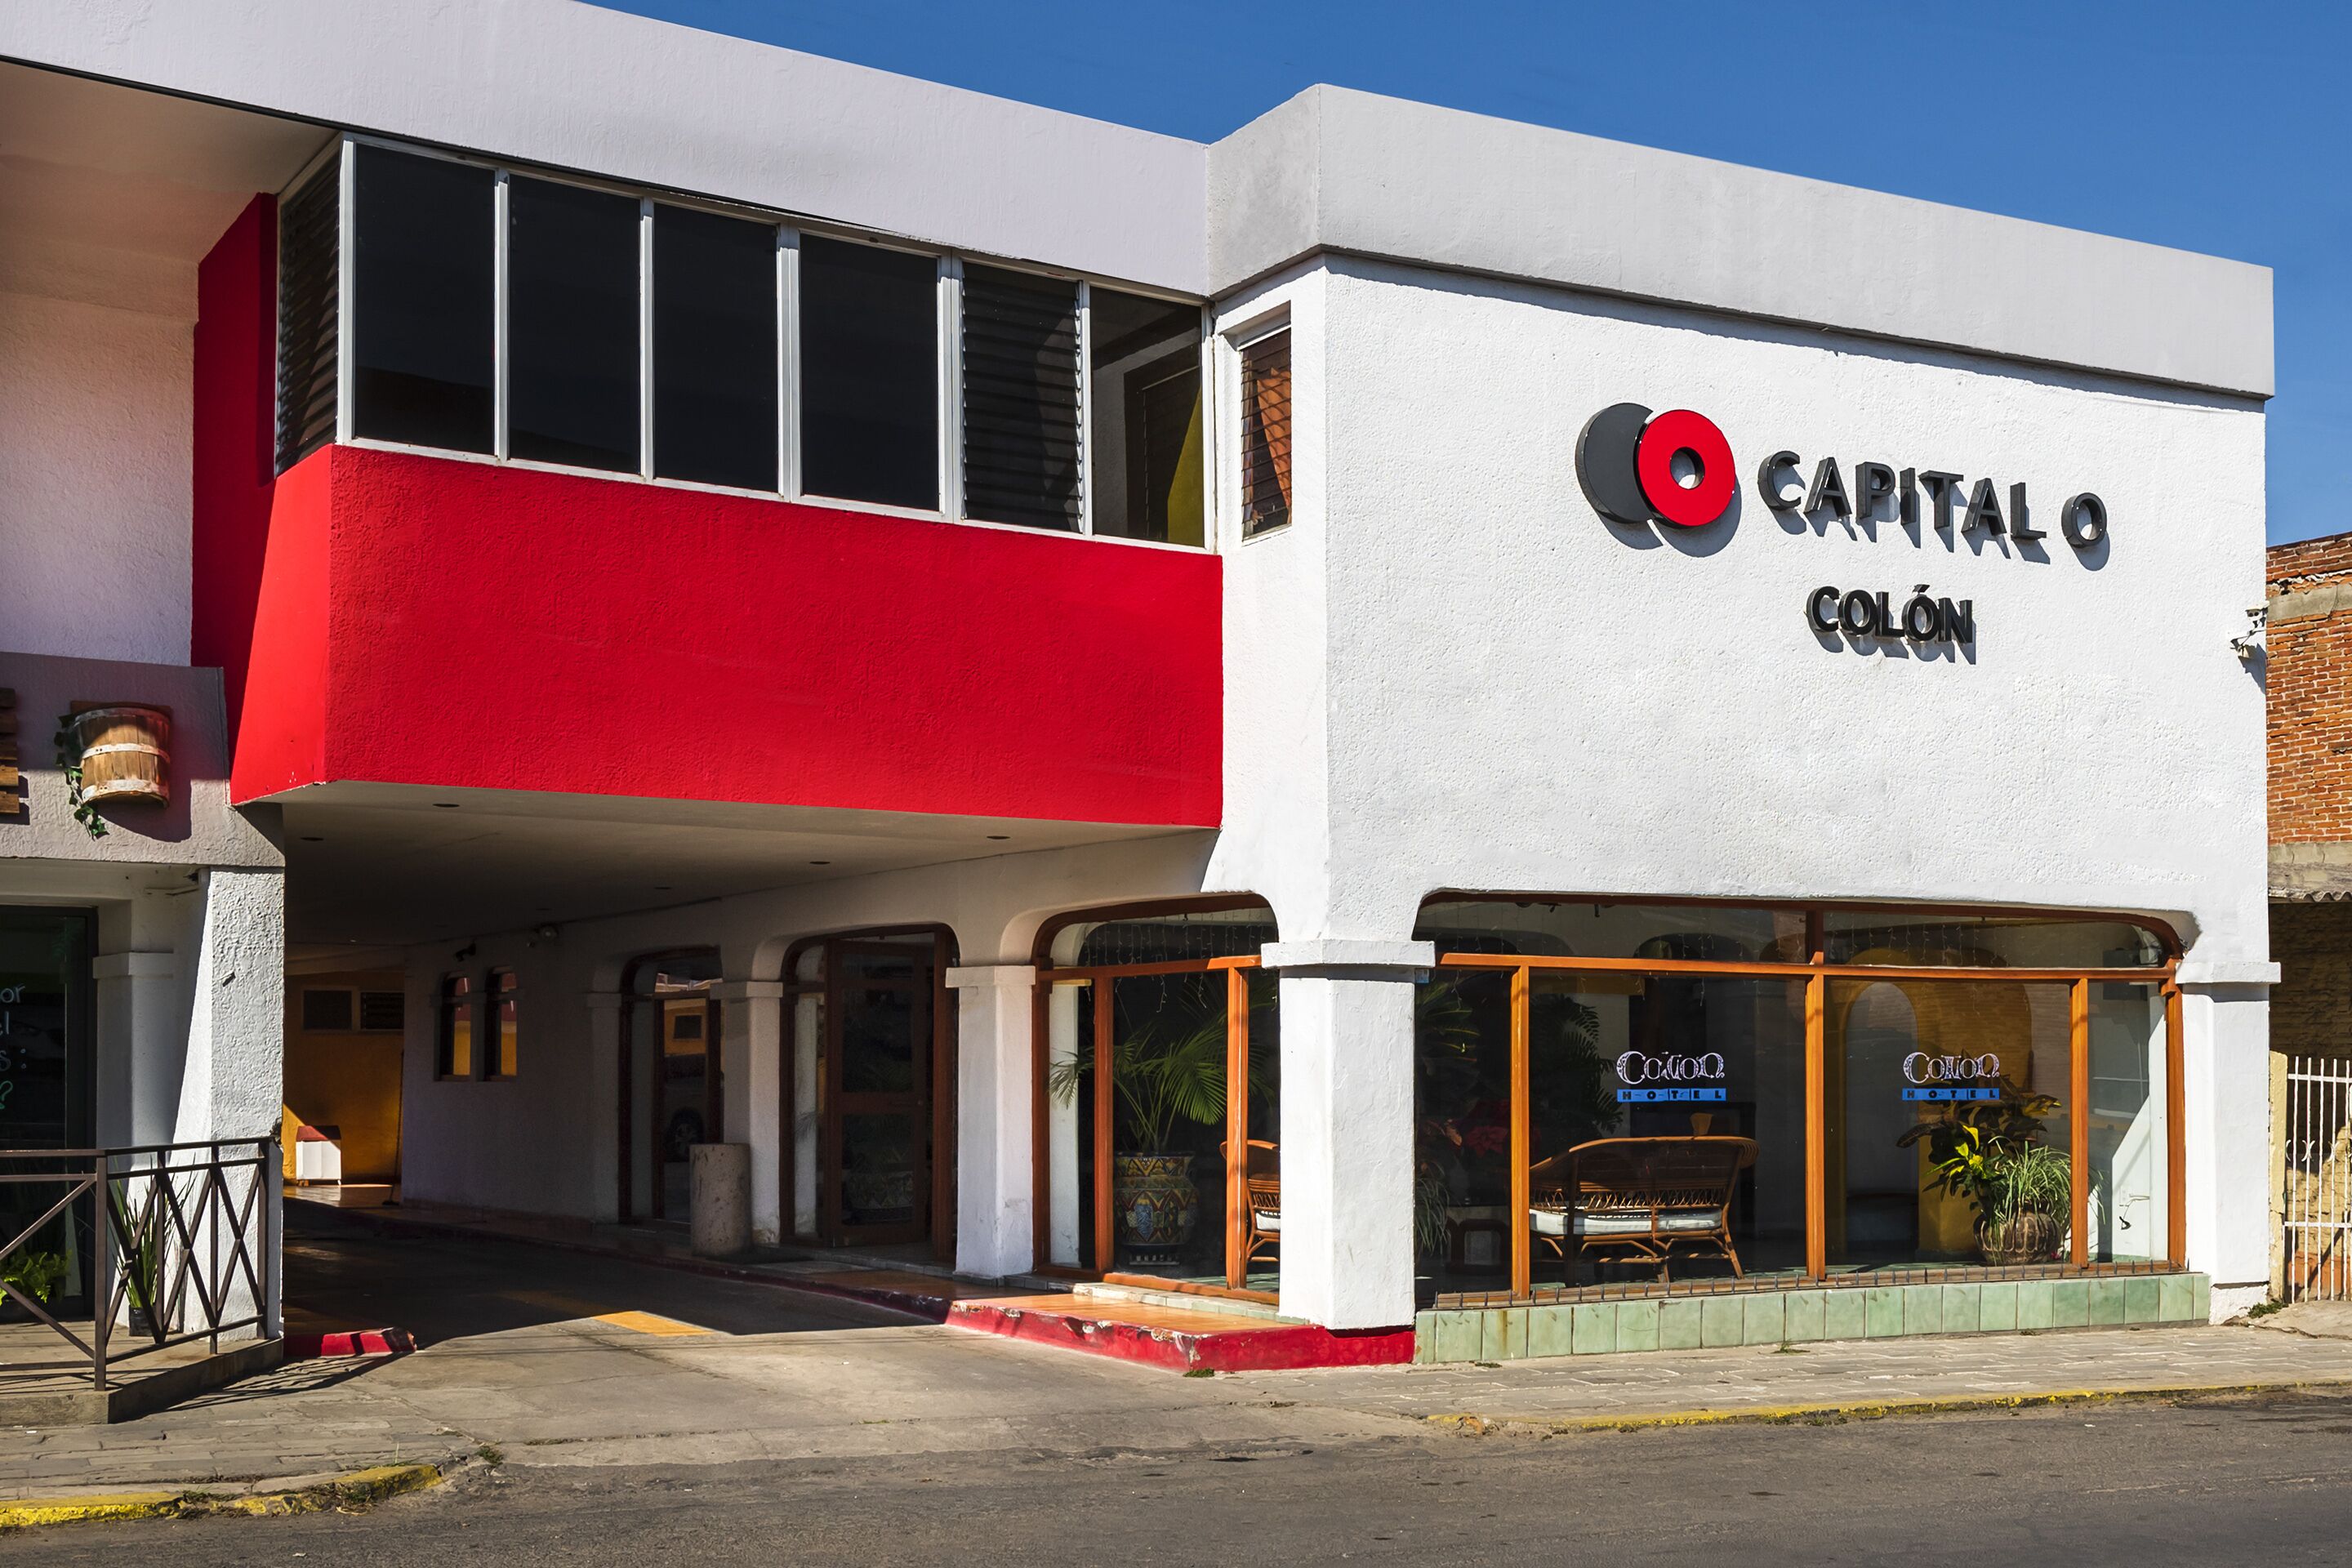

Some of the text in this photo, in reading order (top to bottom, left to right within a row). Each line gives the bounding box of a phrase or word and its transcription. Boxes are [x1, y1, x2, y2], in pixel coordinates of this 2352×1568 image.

[1757, 451, 2108, 549] CAPITAL O
[1806, 584, 1974, 644] COLÓN
[1621, 1089, 1723, 1100] HOTEL
[1906, 1089, 1996, 1099] HOTEL
